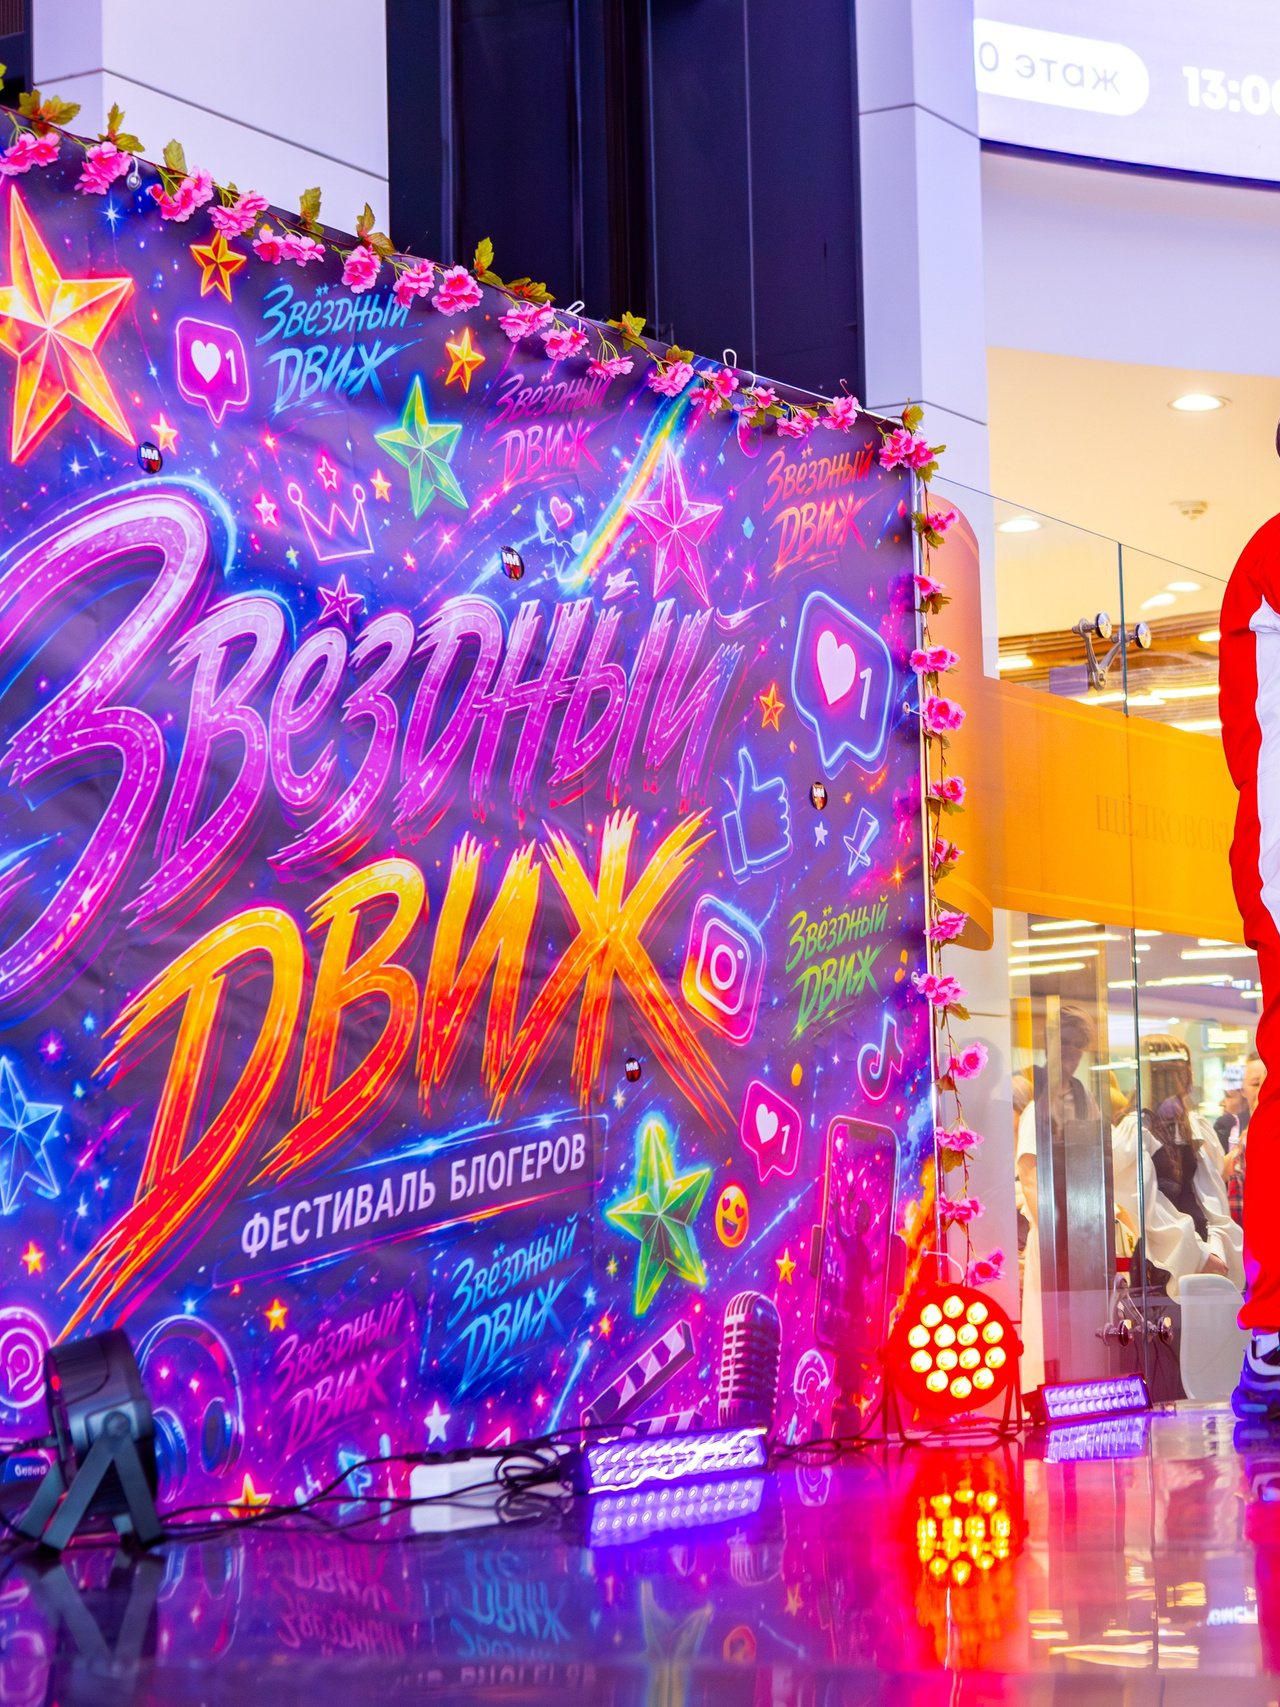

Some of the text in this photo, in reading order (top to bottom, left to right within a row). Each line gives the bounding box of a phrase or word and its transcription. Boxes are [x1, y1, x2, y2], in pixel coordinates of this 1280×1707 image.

[1015, 54, 1120, 94] этаж
[268, 340, 411, 417] ДВИЖ
[492, 417, 603, 488] ДВИЖ
[772, 490, 876, 576] ДВИЖ
[789, 945, 885, 1040] ДВИЖ
[54, 806, 738, 1344] ДВИЖ
[241, 1133, 586, 1259] ФЕСТИВАЛЬ БЛОГЕРОВ
[453, 1275, 577, 1392] ДВИЖ
